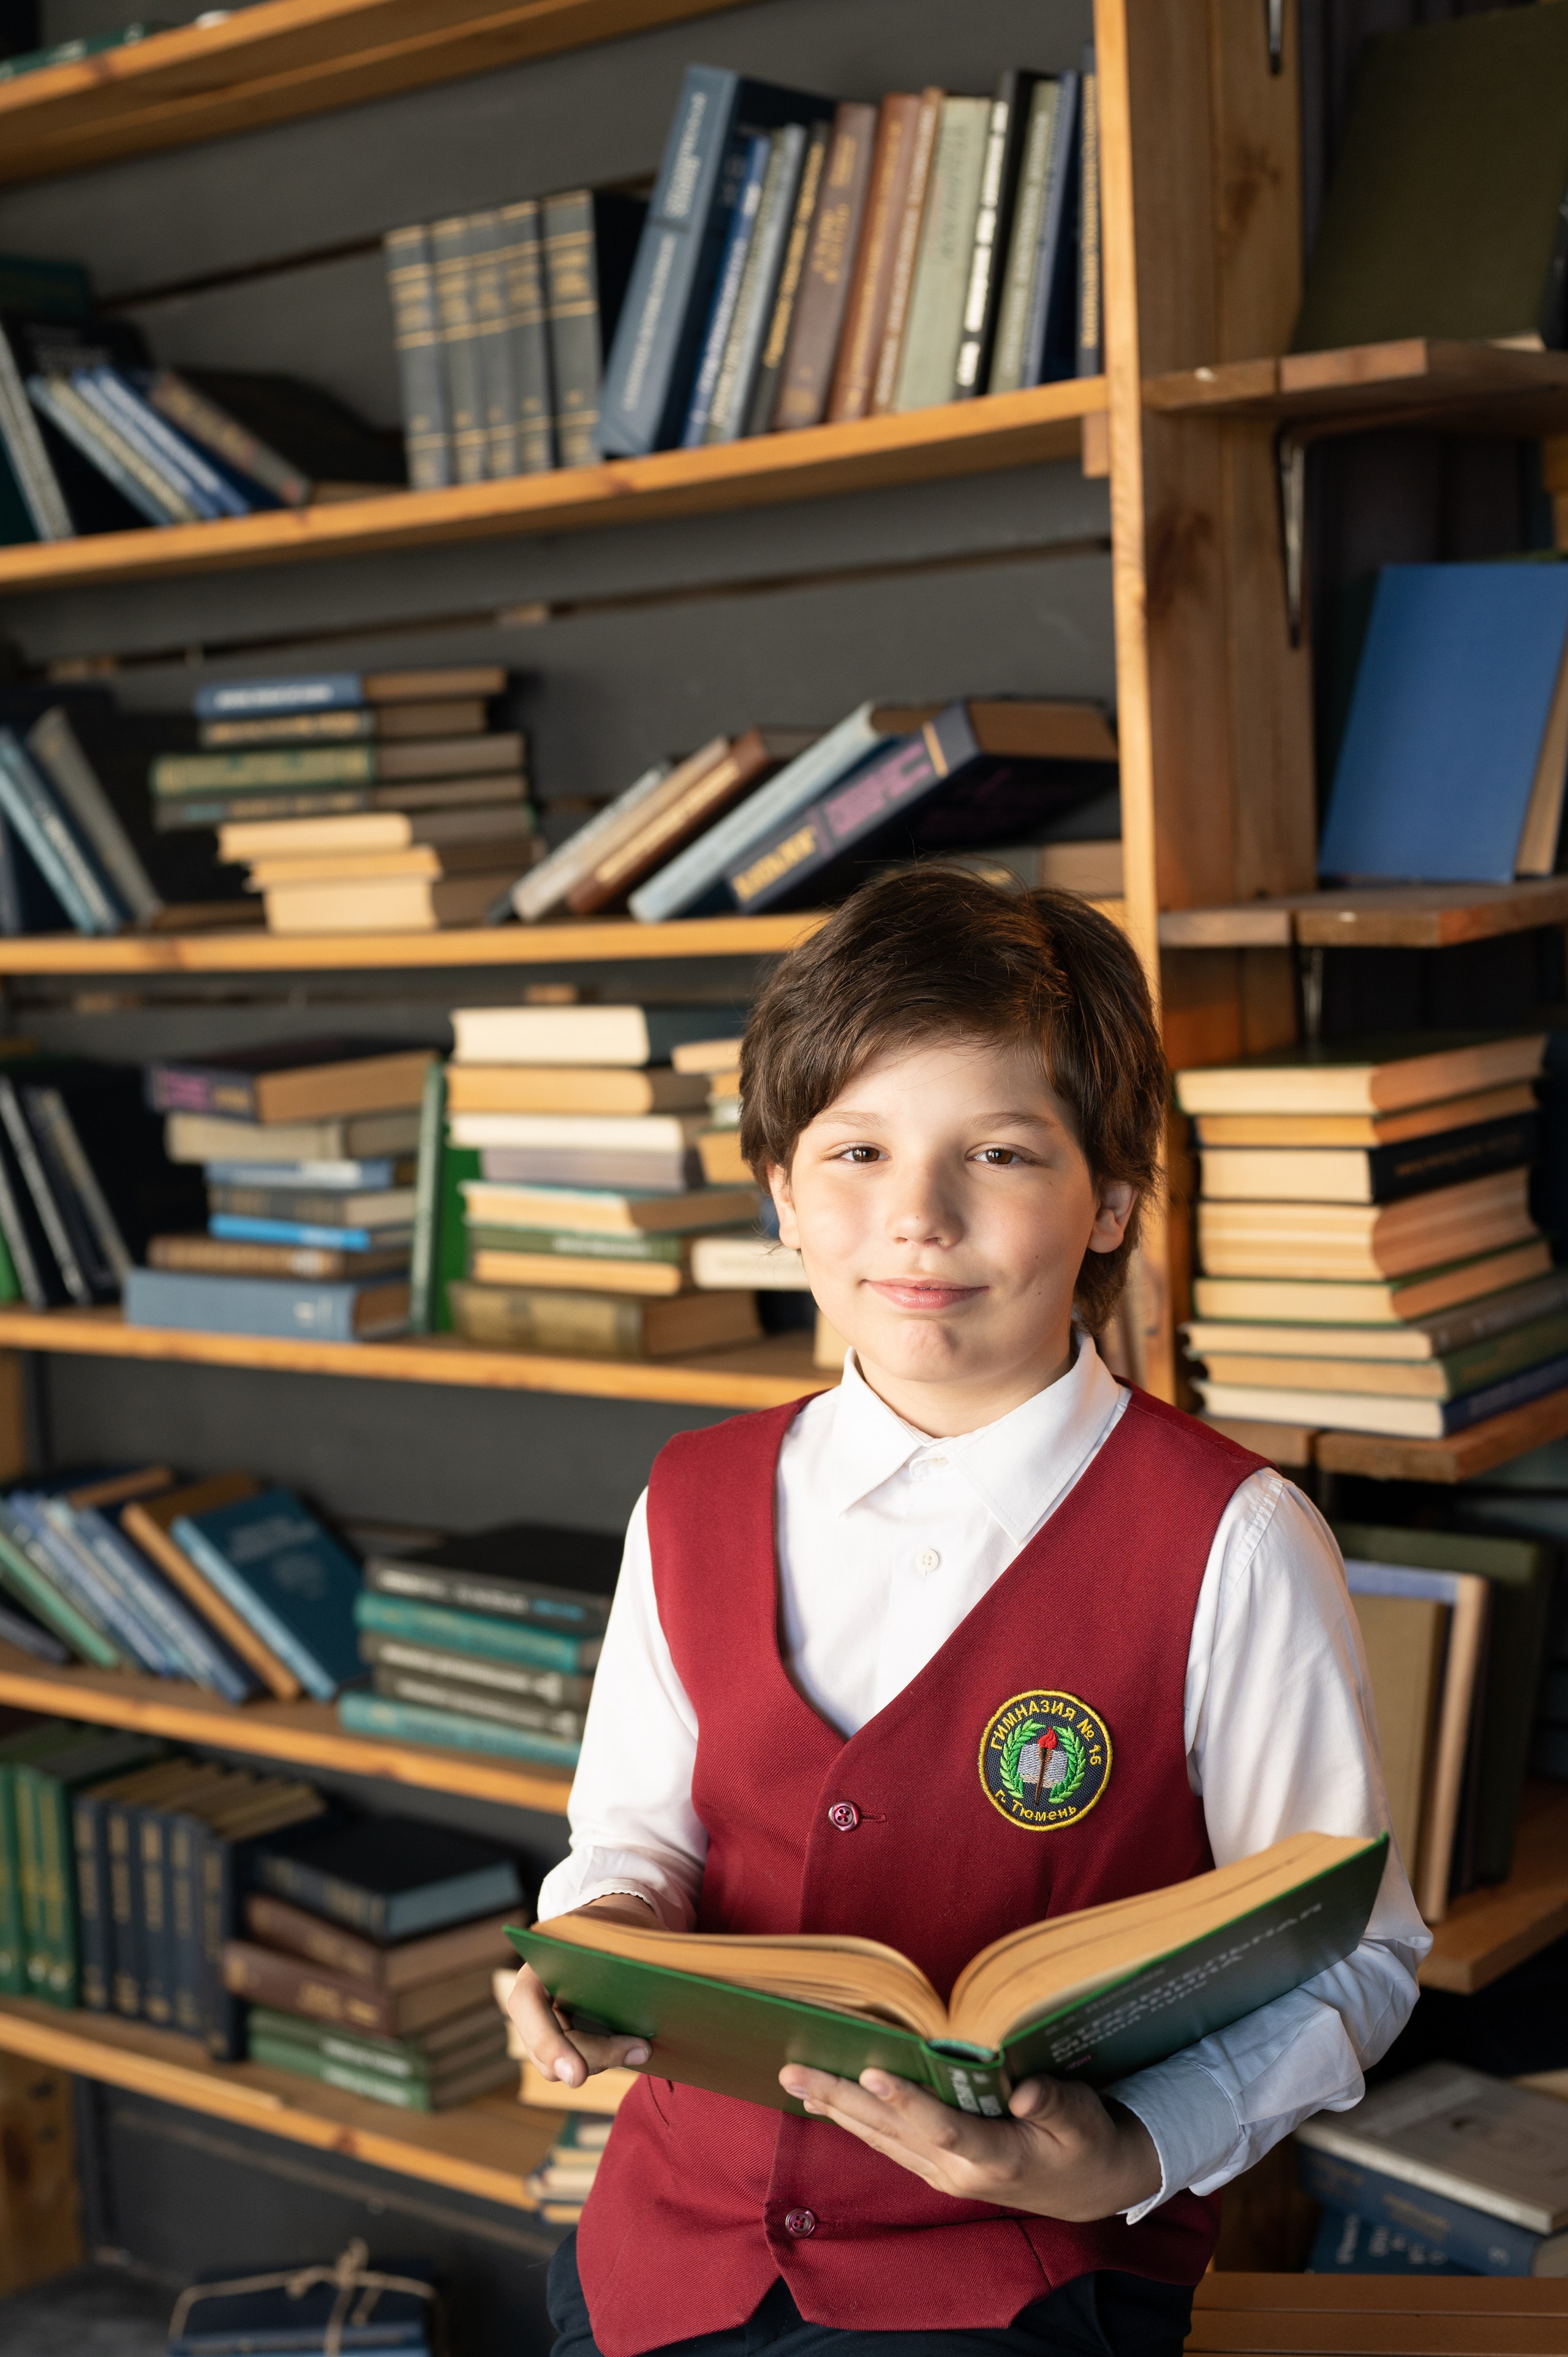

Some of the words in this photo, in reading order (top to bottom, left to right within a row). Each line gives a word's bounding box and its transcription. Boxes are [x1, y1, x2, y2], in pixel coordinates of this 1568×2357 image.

[990, 1700, 1077, 1751] ГИМНАЗИЯ
[1077, 1718, 1095, 1741] №
[1088, 1744, 1102, 1766] 16
[1011, 1799, 1077, 1822] Тюмень
